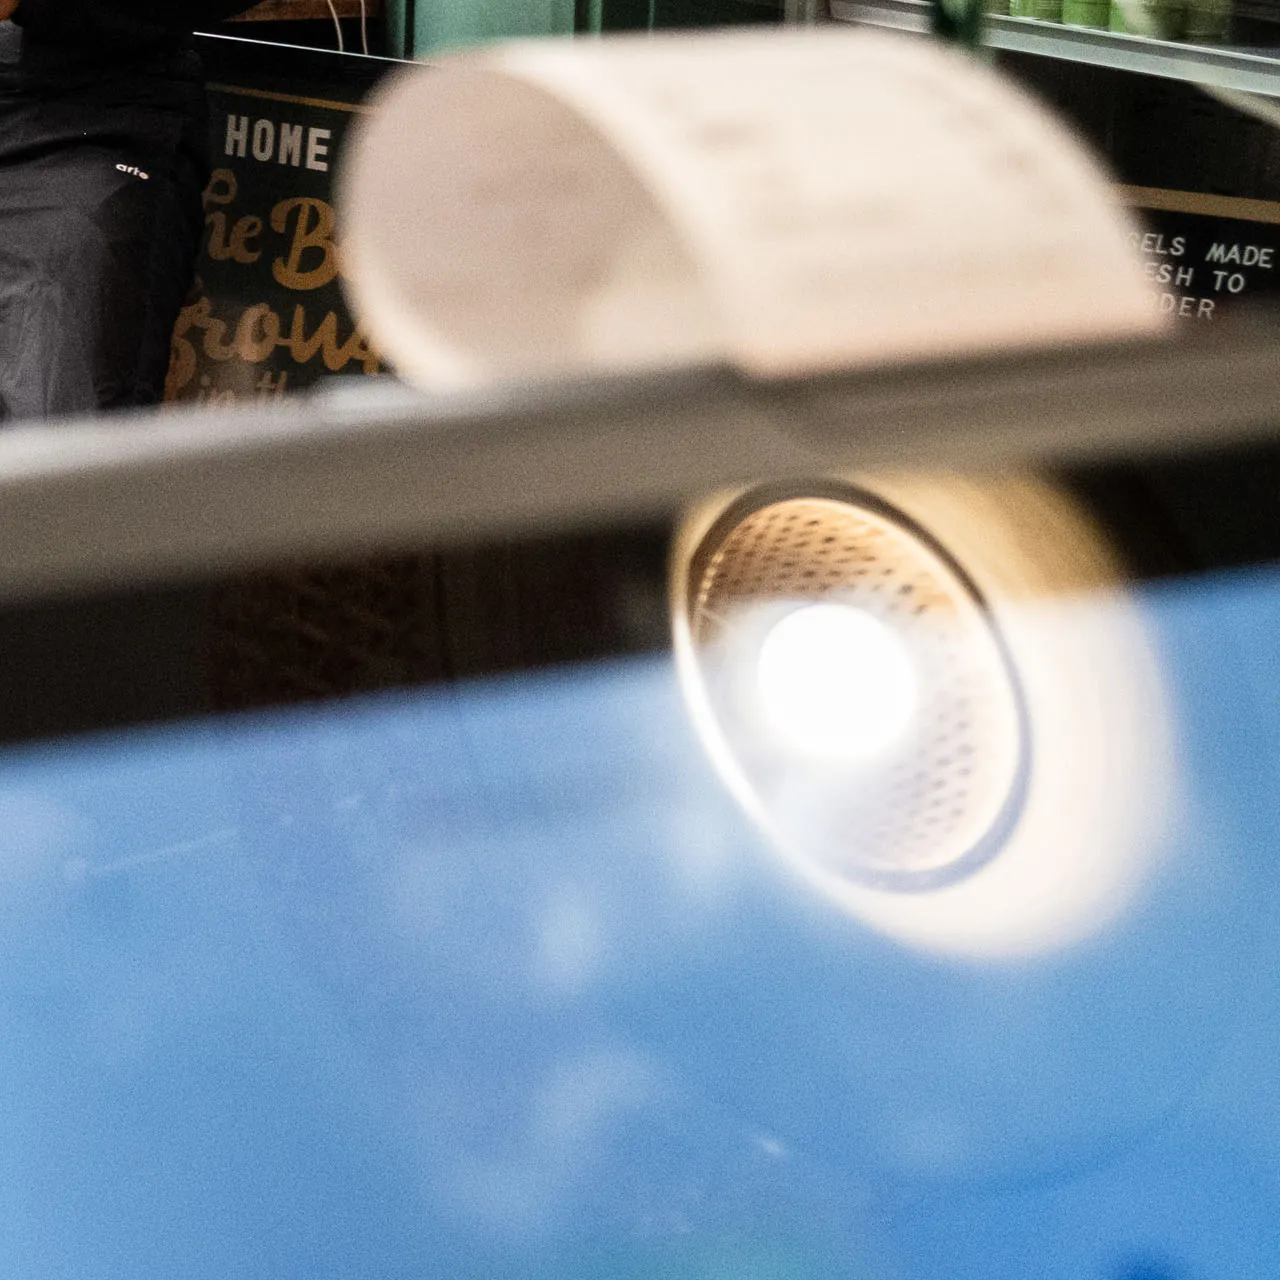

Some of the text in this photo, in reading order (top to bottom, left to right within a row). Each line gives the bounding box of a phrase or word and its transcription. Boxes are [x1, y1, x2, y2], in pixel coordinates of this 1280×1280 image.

[224, 114, 332, 172] HOME
[1205, 242, 1274, 269] MADE
[1143, 261, 1246, 293] ESH TO
[1160, 292, 1216, 320] DER
